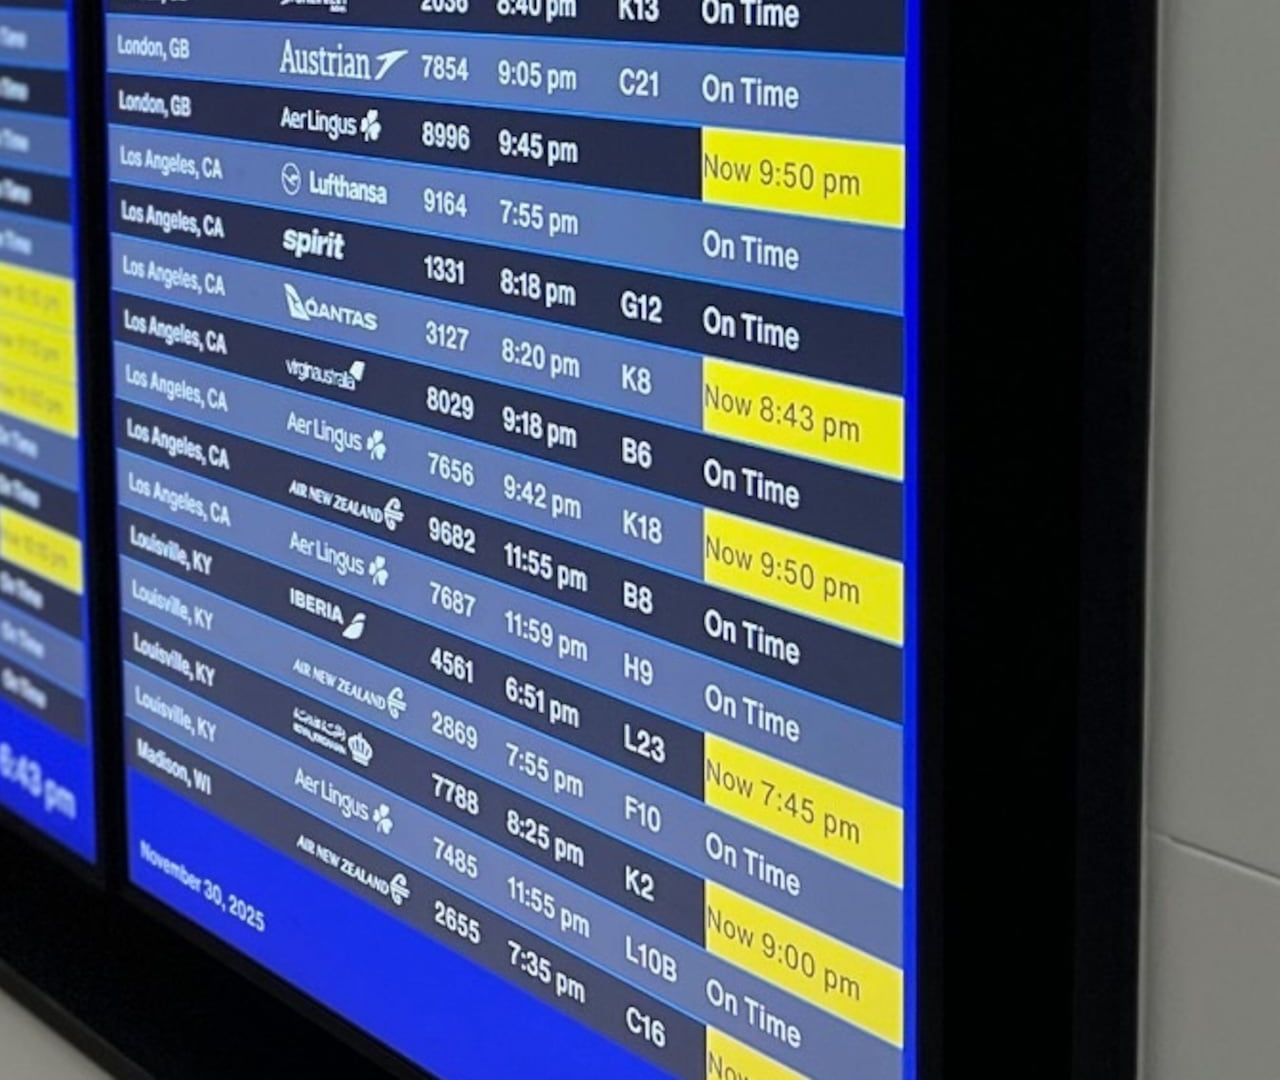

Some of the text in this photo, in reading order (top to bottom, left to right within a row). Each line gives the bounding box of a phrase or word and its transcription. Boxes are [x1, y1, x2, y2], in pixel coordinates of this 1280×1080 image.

[116, 33, 191, 63] London, GB
[278, 38, 373, 81] Austrian
[420, 54, 470, 82] 7854
[497, 58, 578, 95] 9:05 pm
[618, 67, 659, 98] C21
[701, 73, 800, 110] On Time
[118, 144, 224, 181] Los Angeles, CA
[308, 169, 388, 206] Lufthansa
[423, 186, 468, 218] 9164
[119, 198, 226, 239] Los Angeles, CA
[499, 198, 579, 238] 7:55 pm
[281, 227, 346, 261] spirit
[701, 228, 800, 271] On Time
[121, 253, 227, 298] Los Angeles, CA
[423, 254, 465, 286] 1331
[499, 267, 577, 309] 8:18 pm
[305, 296, 379, 332] QANTAS
[620, 290, 663, 325] G12
[702, 304, 801, 351] On Time
[425, 319, 470, 352] 3127
[501, 337, 581, 380] 8:20 pm
[621, 363, 652, 396] K8
[703, 382, 861, 444] Now 8:43 pm
[129, 523, 214, 576] Louisville, KY
[288, 586, 345, 626] IBERIA
[429, 646, 474, 684] 4561
[504, 675, 580, 729] 6:51 pm
[623, 722, 666, 764] L23
[136, 736, 213, 796] Madison, WI
[44, 777, 78, 819] pm
[705, 757, 861, 845] Now 7:45 pm
[140, 839, 267, 932] November 30, 2025
[295, 834, 390, 896] AIR NEW ZEALAND
[433, 899, 481, 945] 2655
[507, 939, 586, 1004] 7:35 pm
[625, 1005, 667, 1048] C16
